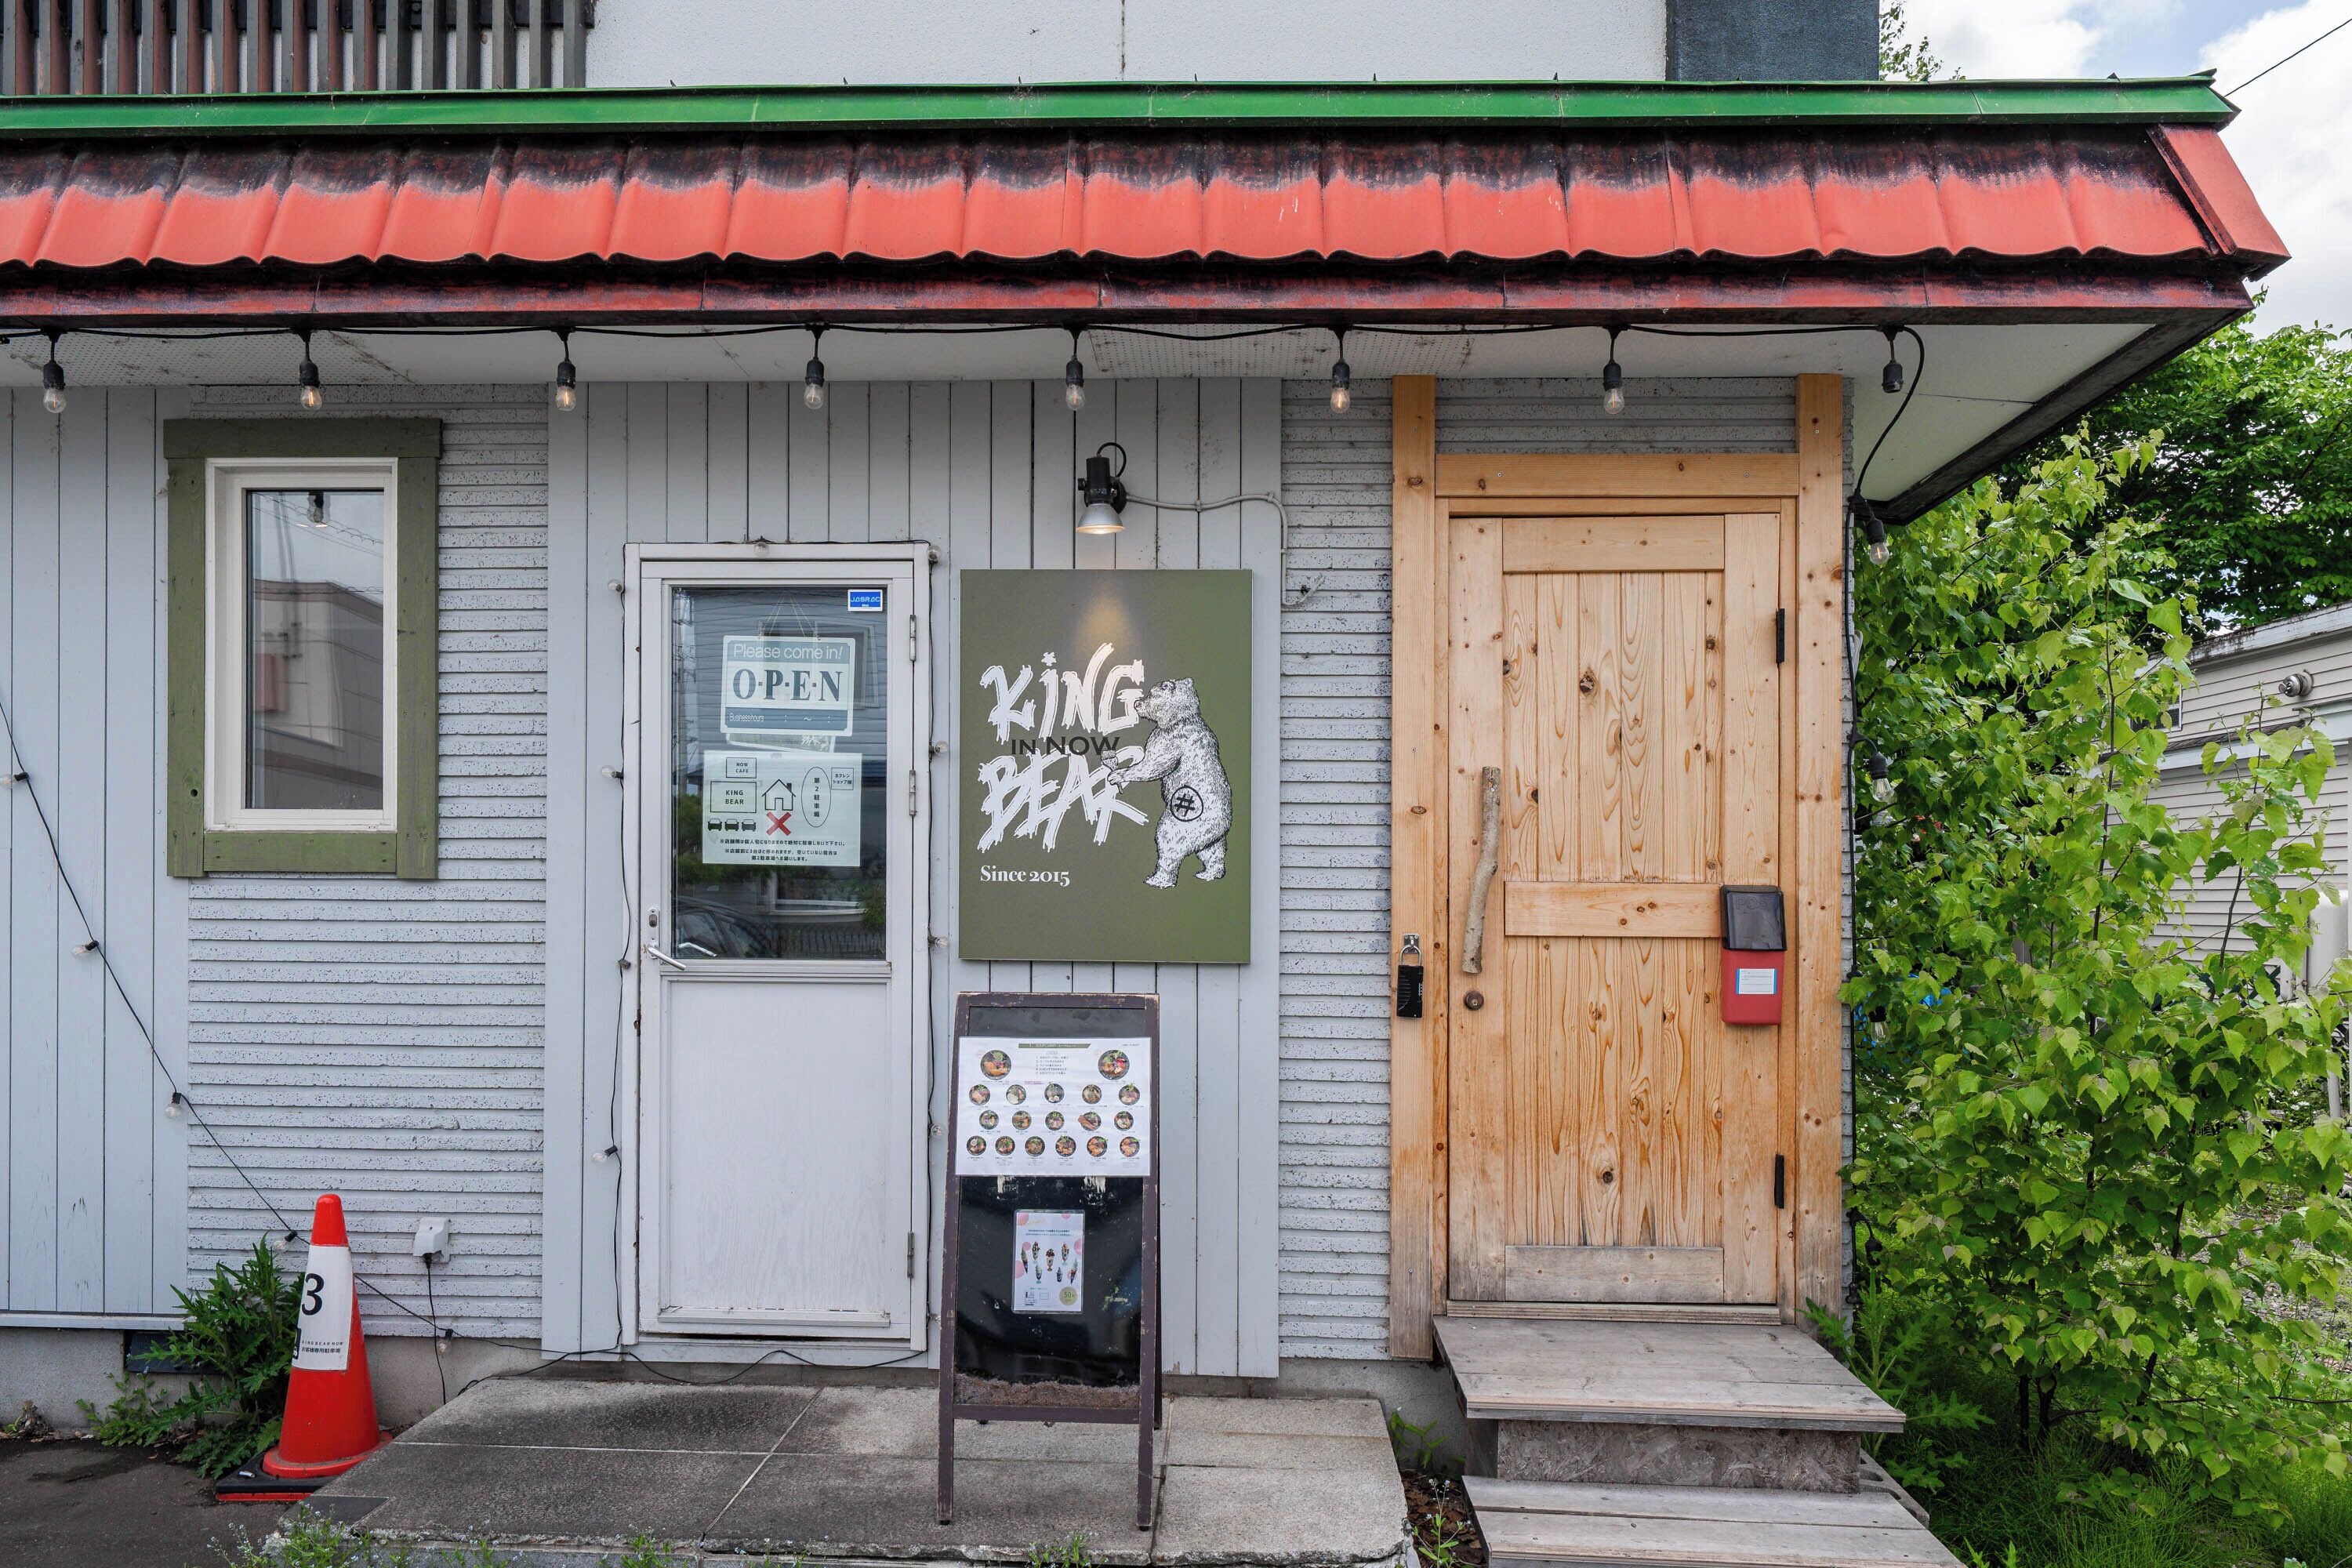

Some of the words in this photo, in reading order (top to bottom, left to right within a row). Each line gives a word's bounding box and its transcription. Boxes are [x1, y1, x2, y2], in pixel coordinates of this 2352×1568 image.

[733, 644, 781, 659] Please
[784, 647, 823, 659] come
[826, 645, 844, 659] in!
[1011, 739, 1036, 755] IN
[1046, 736, 1120, 755] NOW
[977, 745, 1150, 852] BEAR
[980, 865, 1026, 883] Since
[1029, 870, 1070, 887] 2015
[301, 1272, 325, 1316] 3
